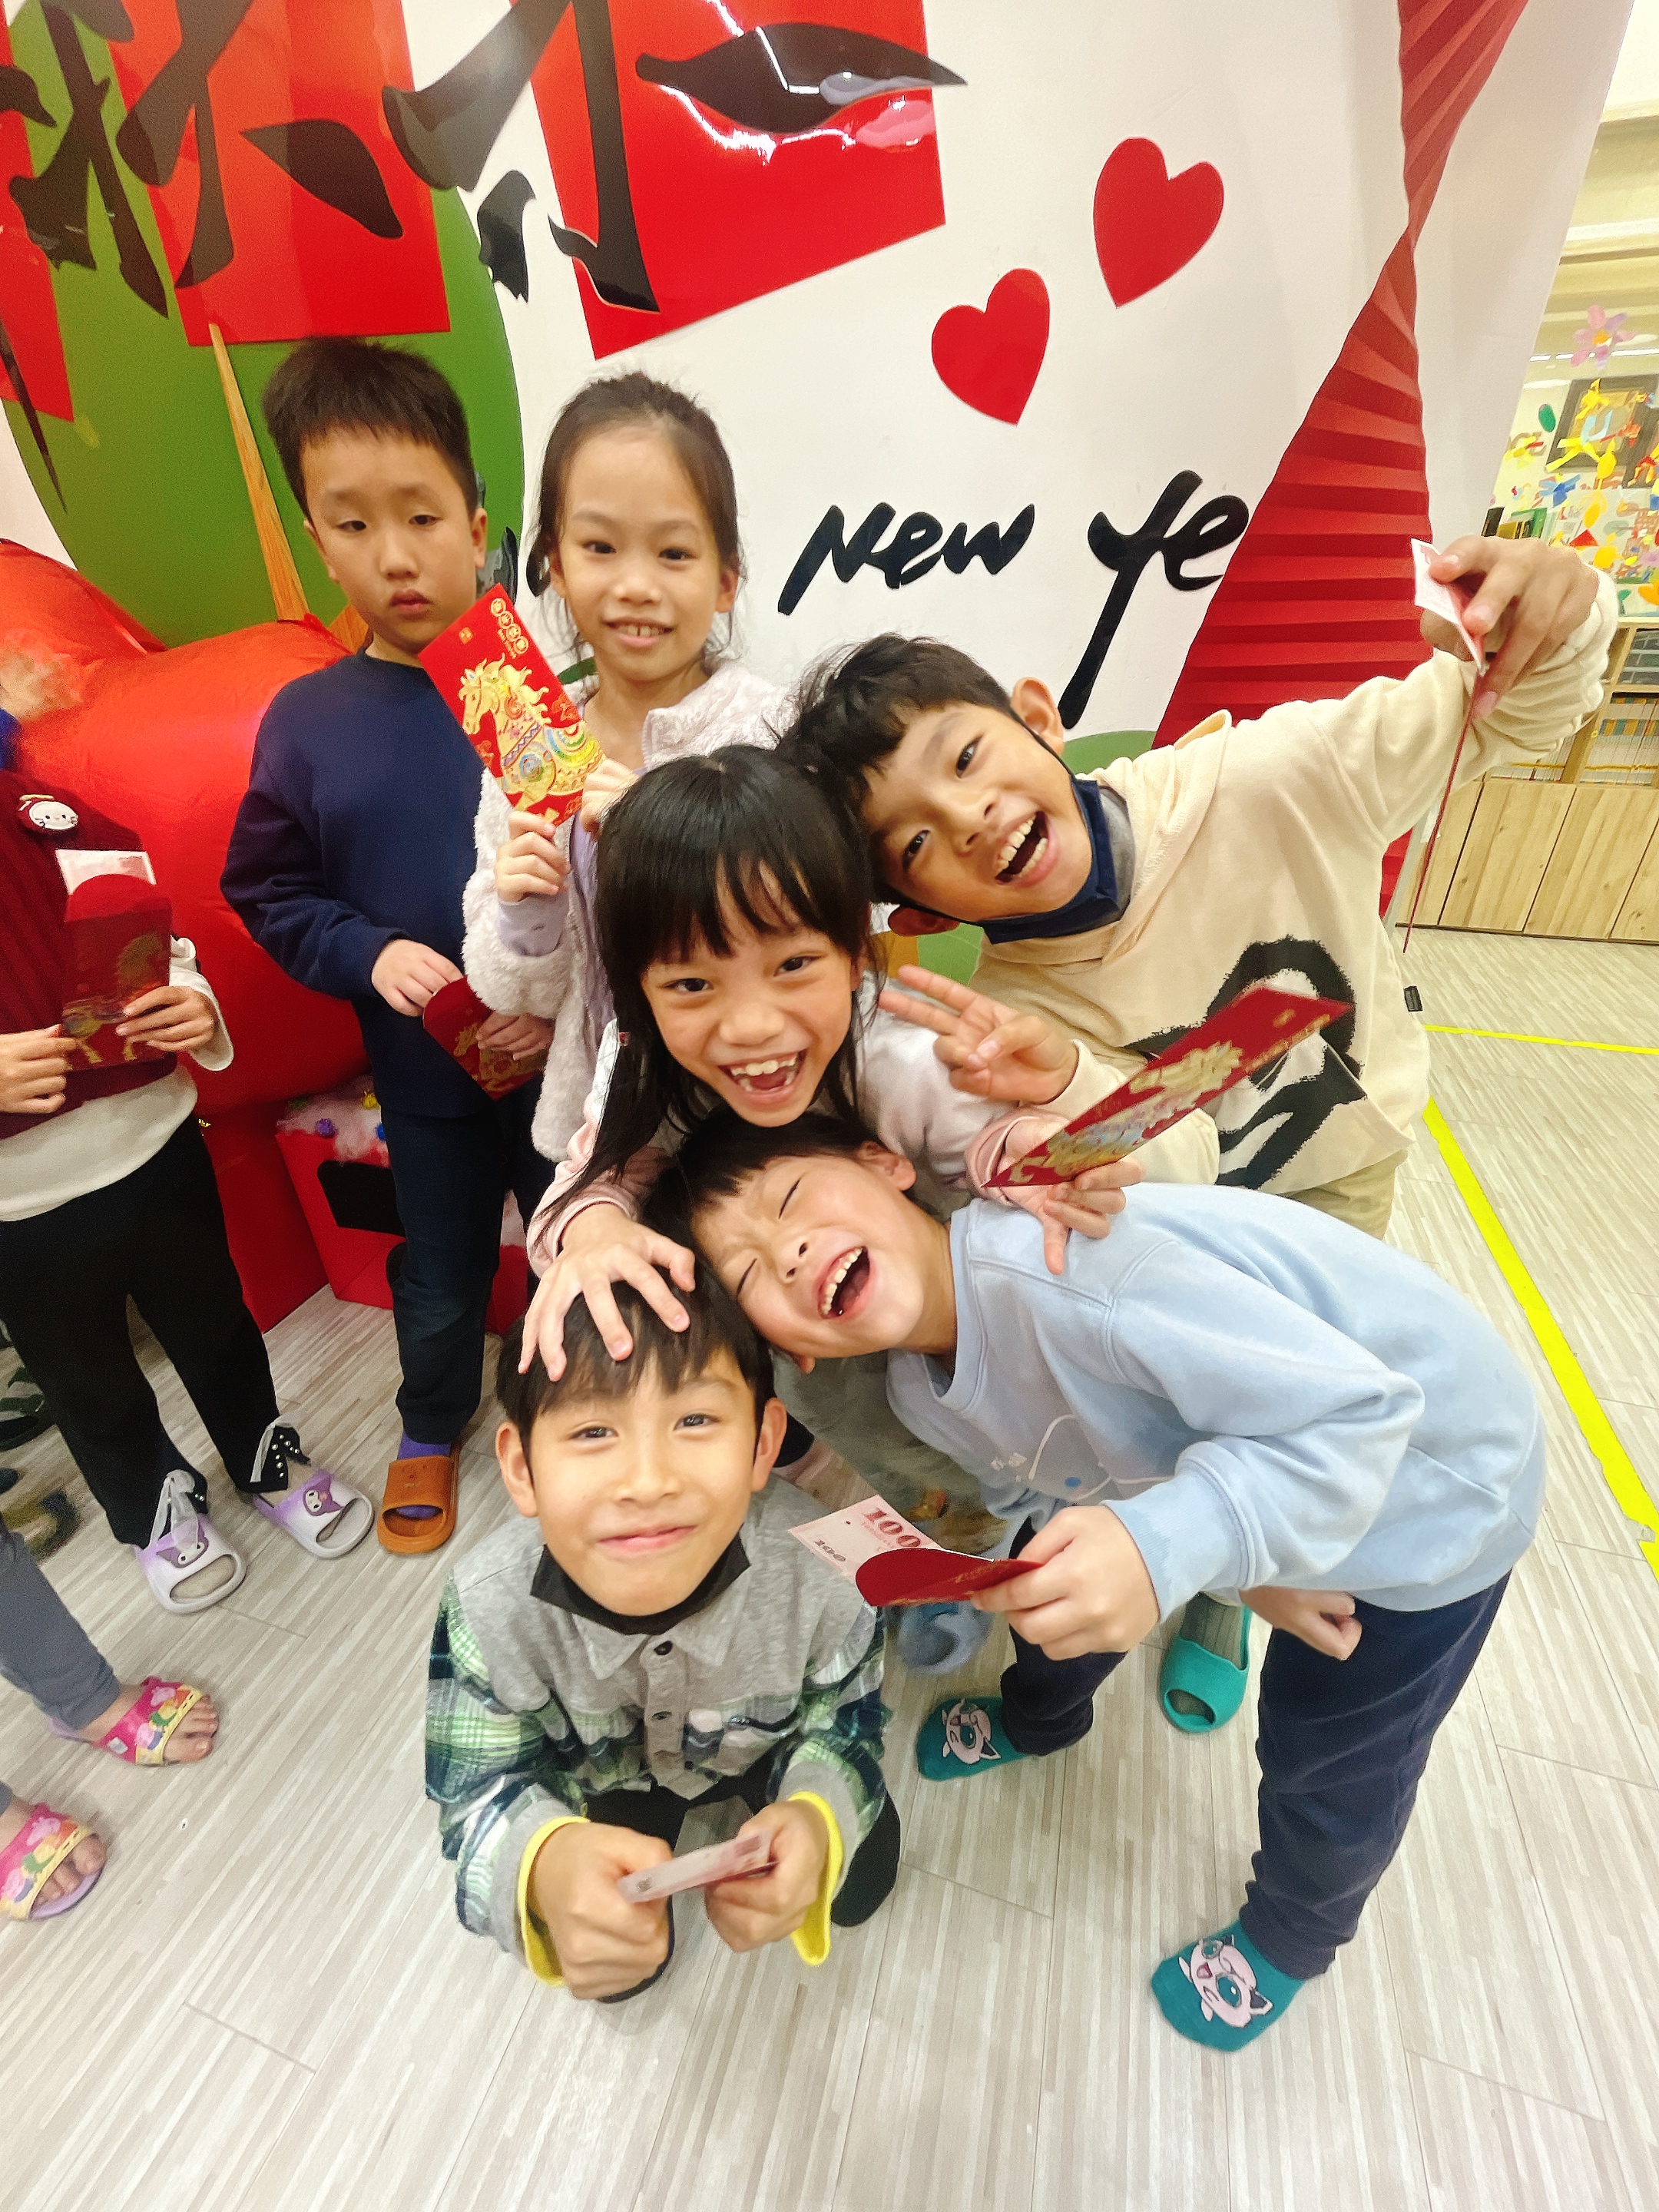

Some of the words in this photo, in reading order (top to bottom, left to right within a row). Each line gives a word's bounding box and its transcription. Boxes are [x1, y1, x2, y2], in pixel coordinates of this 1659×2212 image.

[777, 502, 1035, 616] New
[862, 1508, 922, 1548] 100
[815, 1539, 846, 1562] 100
